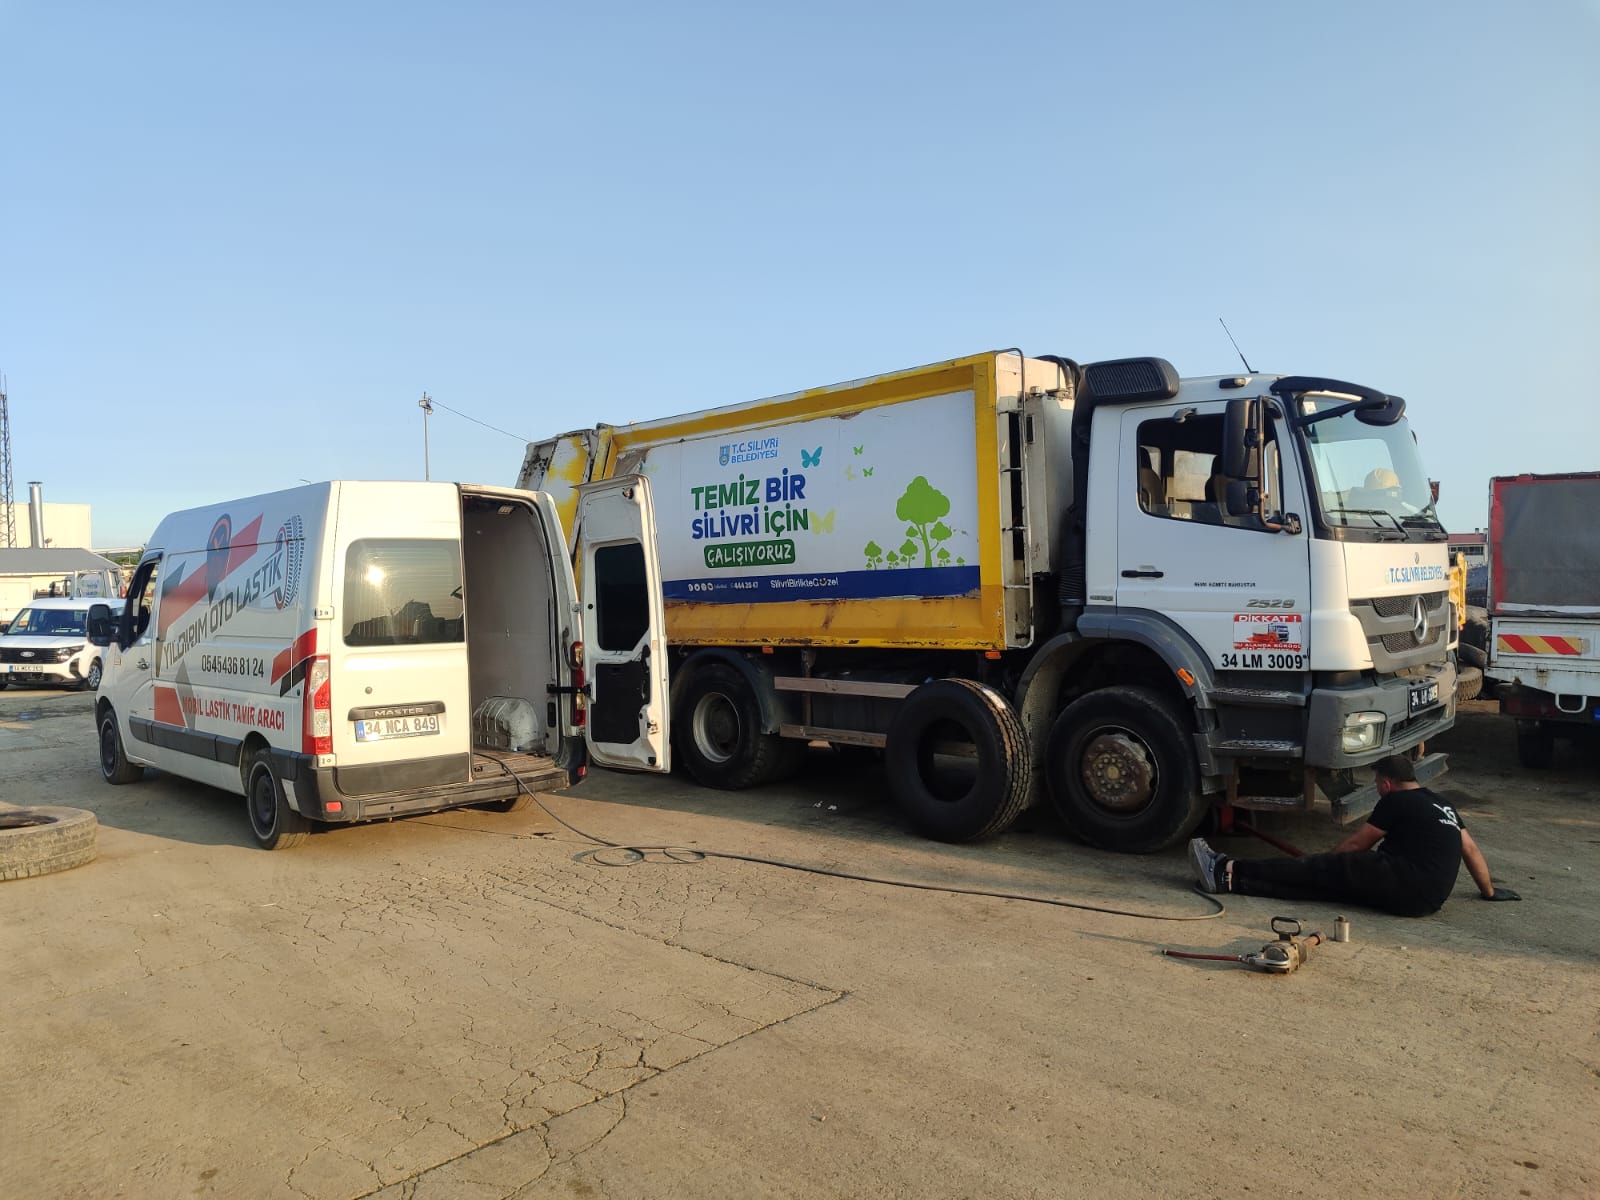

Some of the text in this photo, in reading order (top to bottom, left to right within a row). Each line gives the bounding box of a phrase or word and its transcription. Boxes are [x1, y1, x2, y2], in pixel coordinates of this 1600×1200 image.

[732, 443, 745, 454] T.C.
[691, 467, 806, 511] TEMİZ BİR
[692, 502, 809, 540] SİLİVRİ İÇİN
[707, 543, 792, 567] ÇALIŞIYORUZ
[163, 552, 283, 669] YILDIRIM OTO LASTİK
[1246, 598, 1296, 609] 2529
[239, 657, 250, 676] 81
[252, 657, 264, 678] 24
[1221, 653, 1303, 669] 34 LM 3009
[206, 698, 230, 720] LASTİK
[257, 707, 285, 731] ARACI
[375, 707, 424, 717] MASTER
[365, 717, 436, 735] 34 NCA 849
